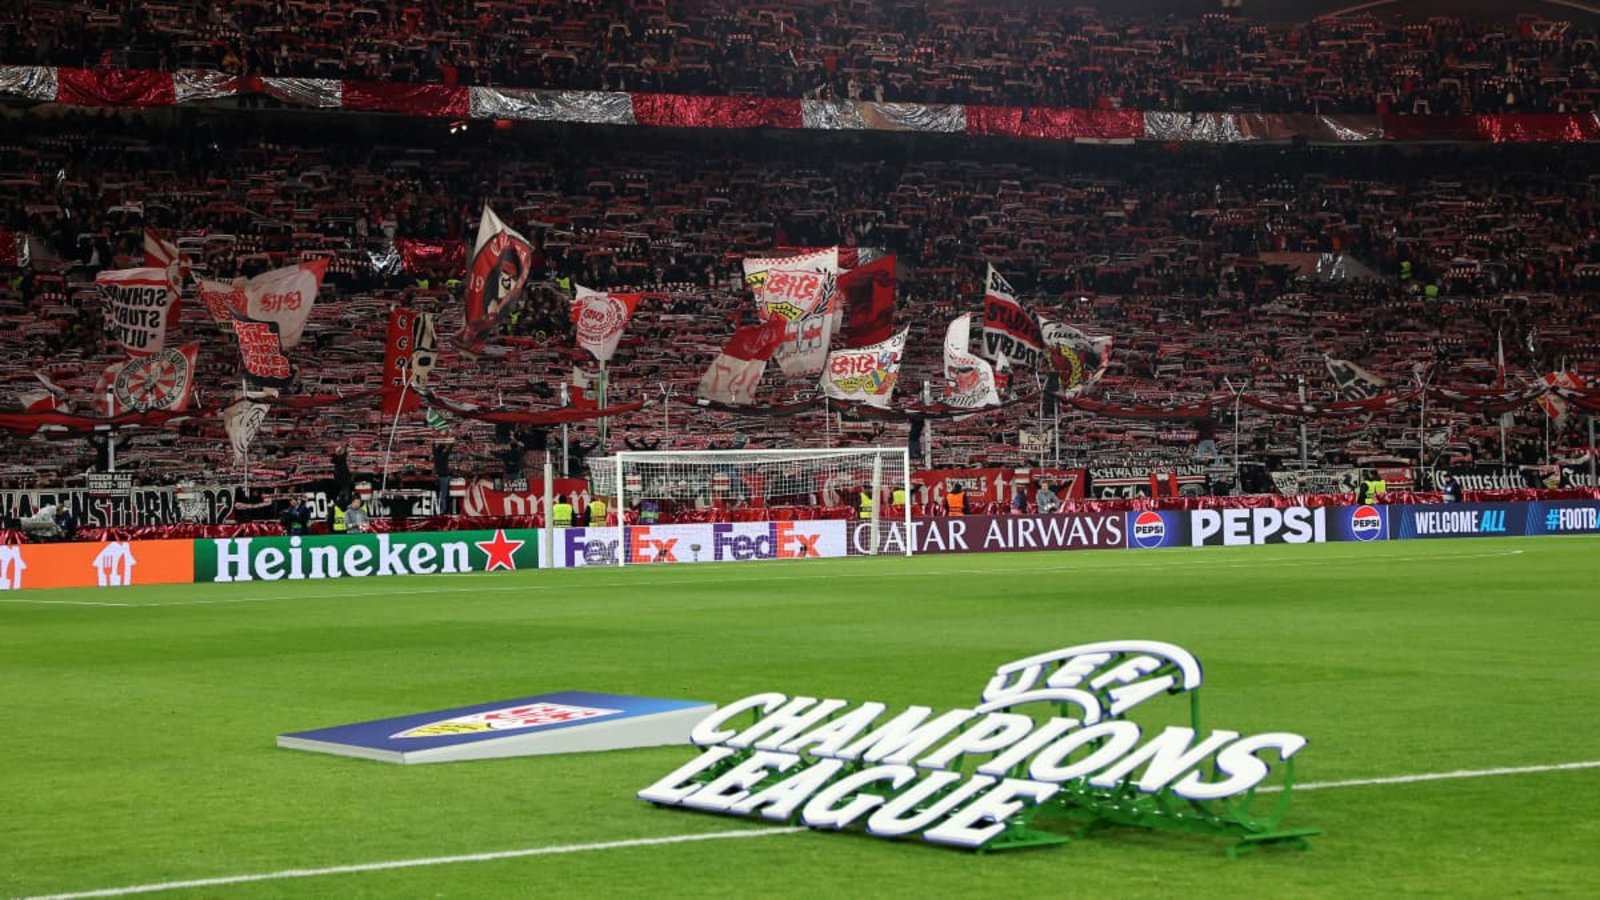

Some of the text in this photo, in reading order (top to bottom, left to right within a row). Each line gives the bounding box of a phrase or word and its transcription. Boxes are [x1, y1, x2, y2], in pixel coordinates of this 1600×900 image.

[713, 522, 820, 560] FedEx
[853, 515, 1122, 554] QATAR AIRWAYS
[1135, 524, 1163, 535] PEPSI
[1191, 506, 1326, 546] PEPSI
[1353, 519, 1380, 528] PEPSI
[1415, 510, 1506, 534] WELCOME ALL
[214, 534, 472, 583] Heineken
[565, 526, 678, 567] FedEx
[983, 652, 1178, 715] UEFA
[691, 692, 1308, 800] CHAMPIONS
[637, 746, 1060, 849] LEAGUE
